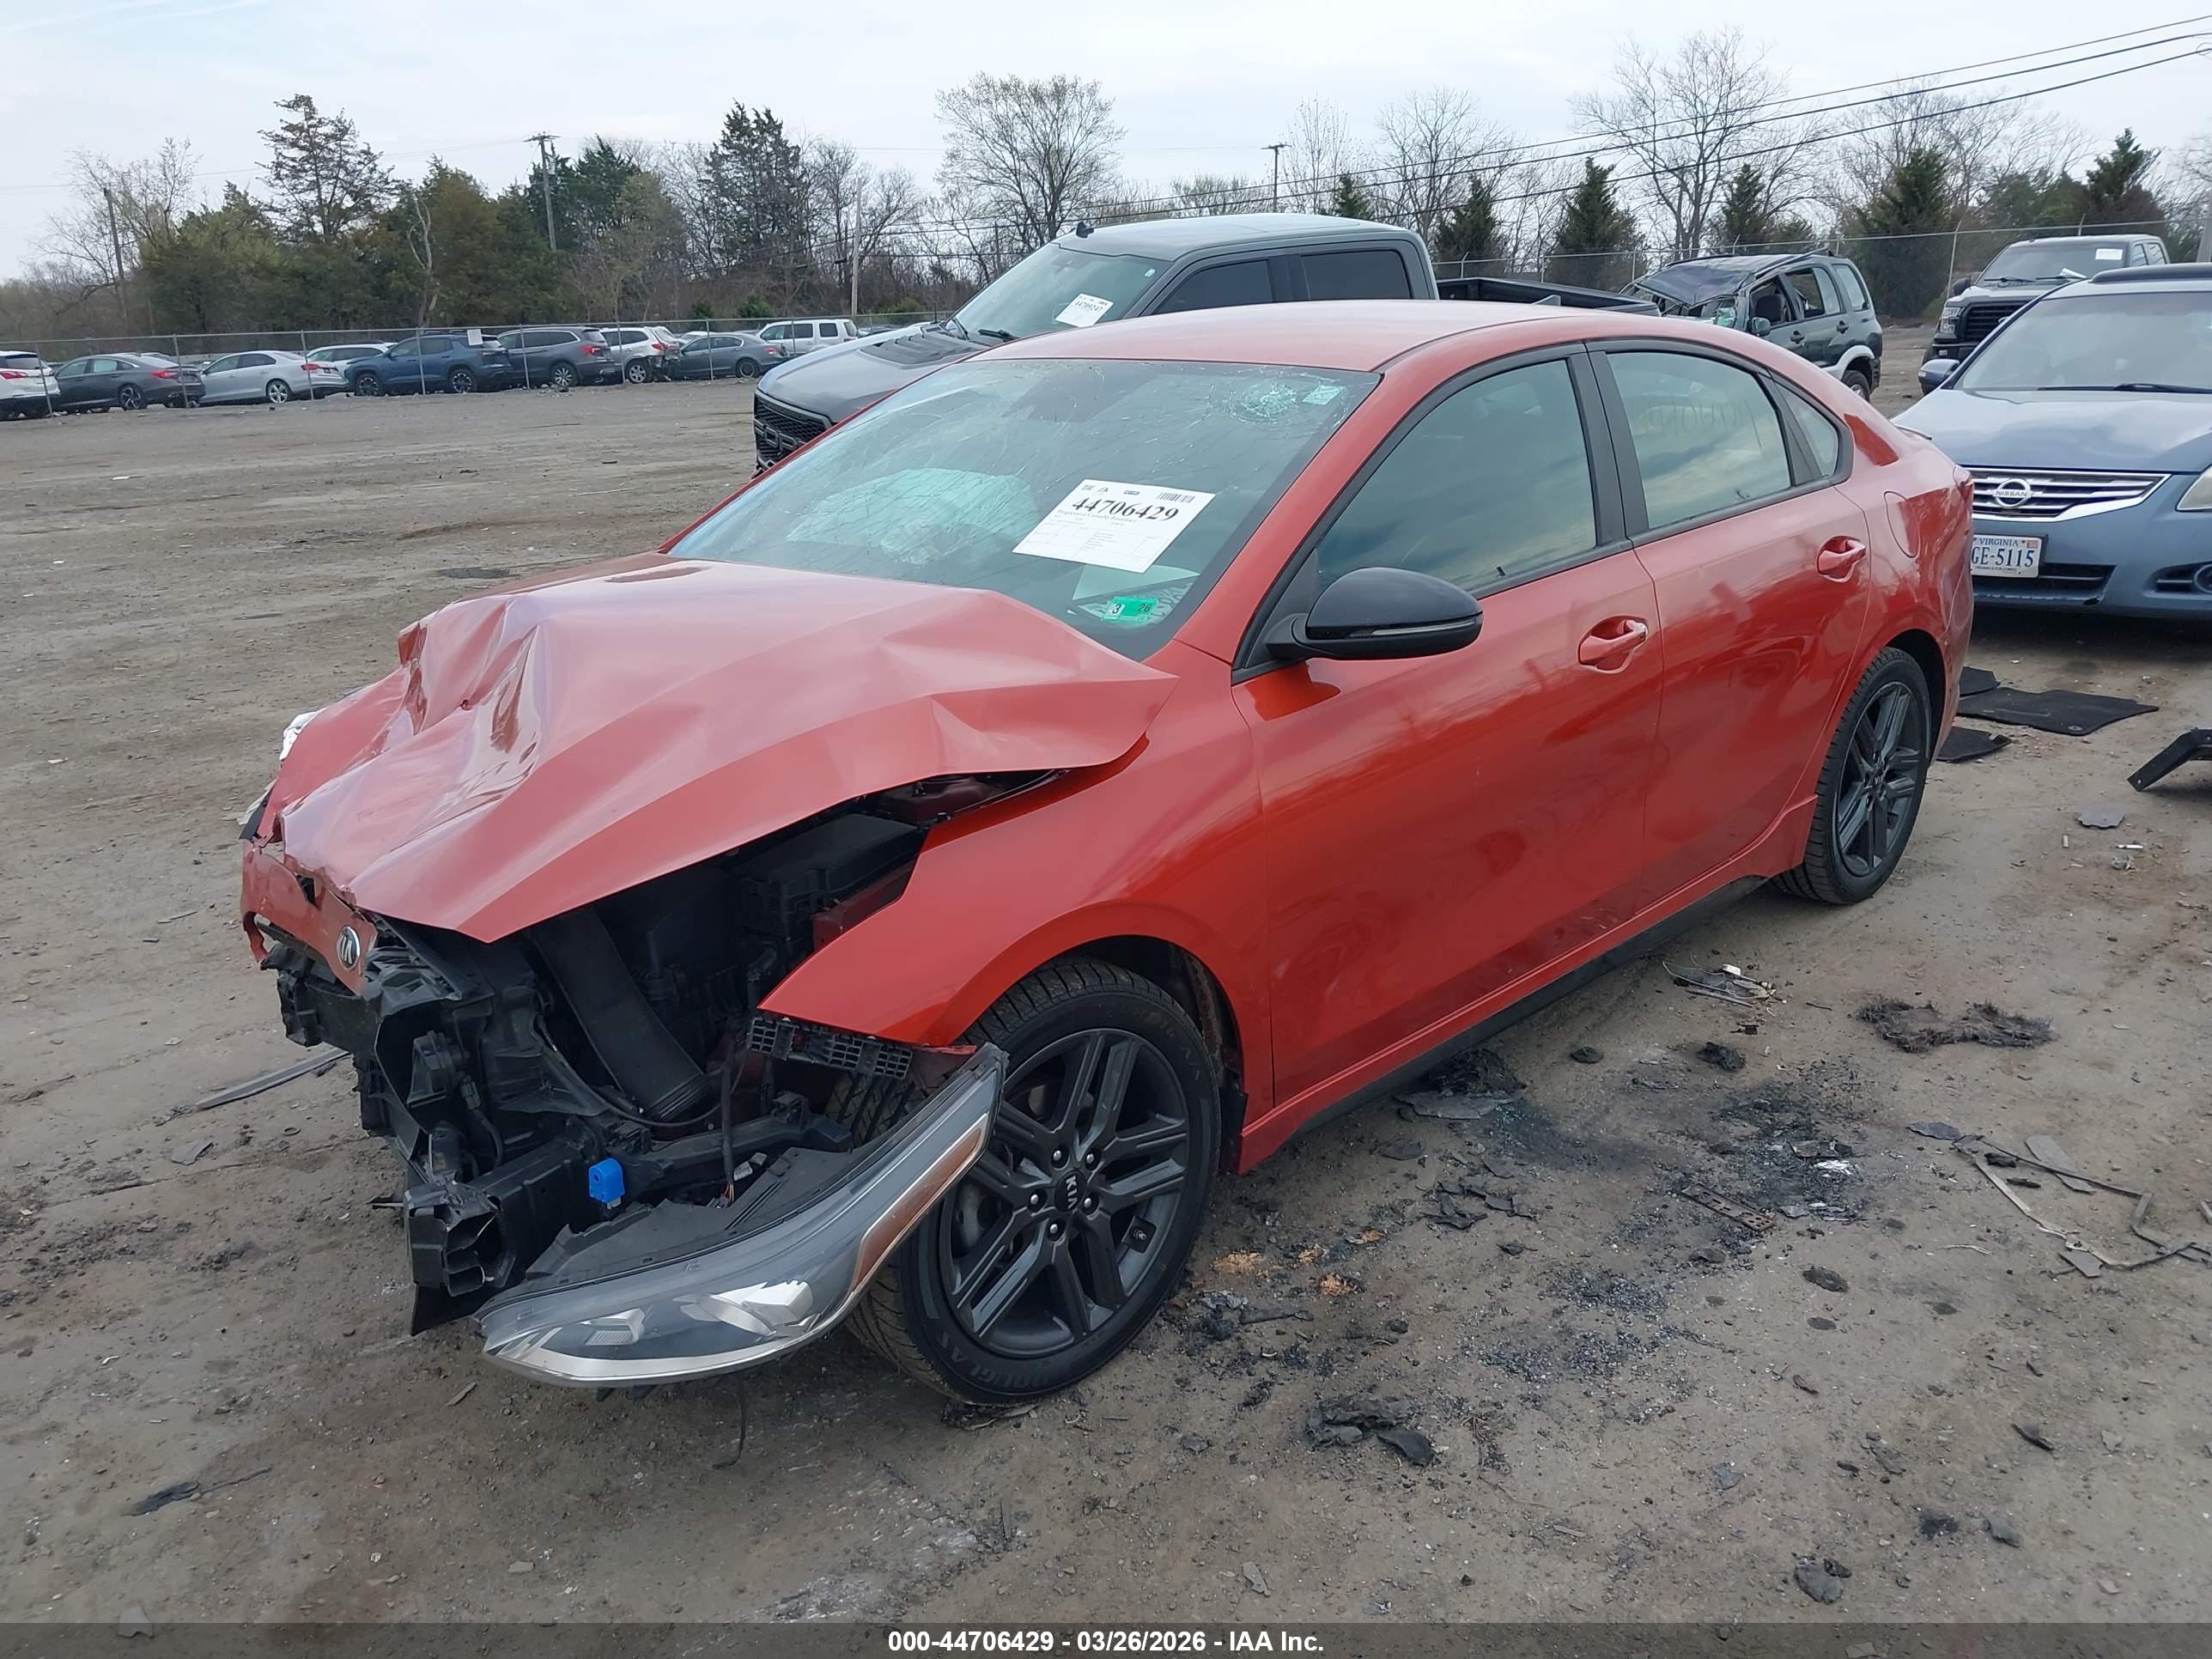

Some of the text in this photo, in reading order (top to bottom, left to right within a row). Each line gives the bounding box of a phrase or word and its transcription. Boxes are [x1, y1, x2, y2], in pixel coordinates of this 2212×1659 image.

[1072, 496, 1180, 521] 44706429
[1978, 538, 2019, 547] VIRGINIA
[1112, 603, 1152, 614] 3 26
[1066, 1174, 1078, 1210] KIA
